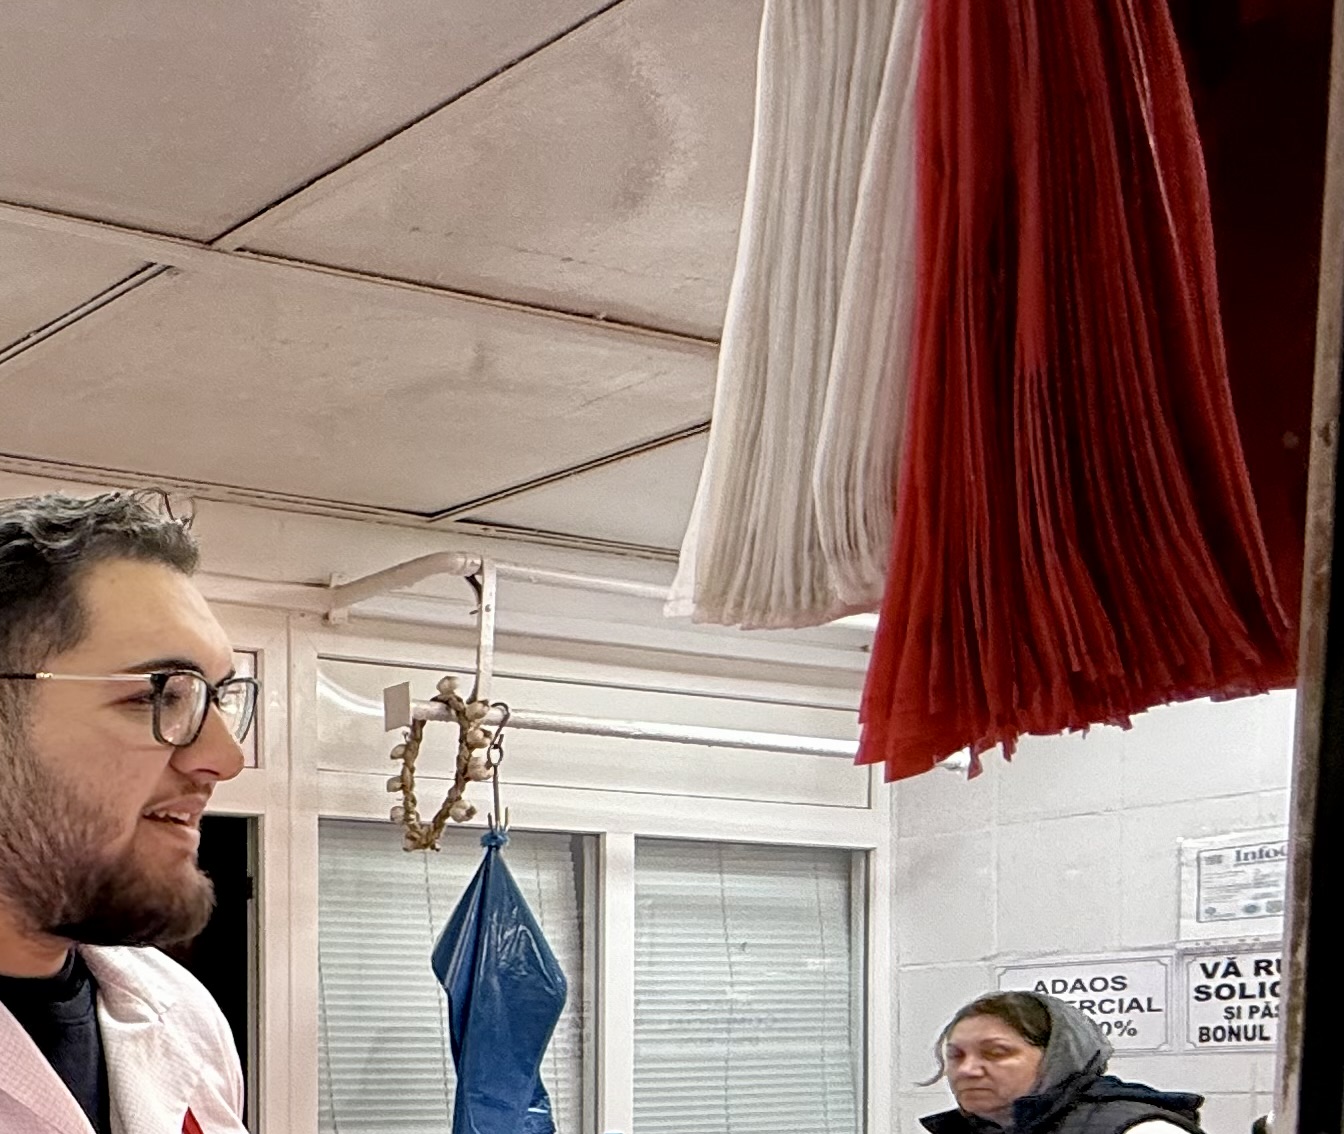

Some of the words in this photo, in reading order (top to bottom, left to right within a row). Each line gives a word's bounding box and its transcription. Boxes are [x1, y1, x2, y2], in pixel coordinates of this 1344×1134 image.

[1199, 956, 1243, 979] VĂ
[1034, 975, 1128, 994] ADAOS
[1064, 997, 1163, 1015] RCIAL
[1198, 1024, 1272, 1043] BONUL
